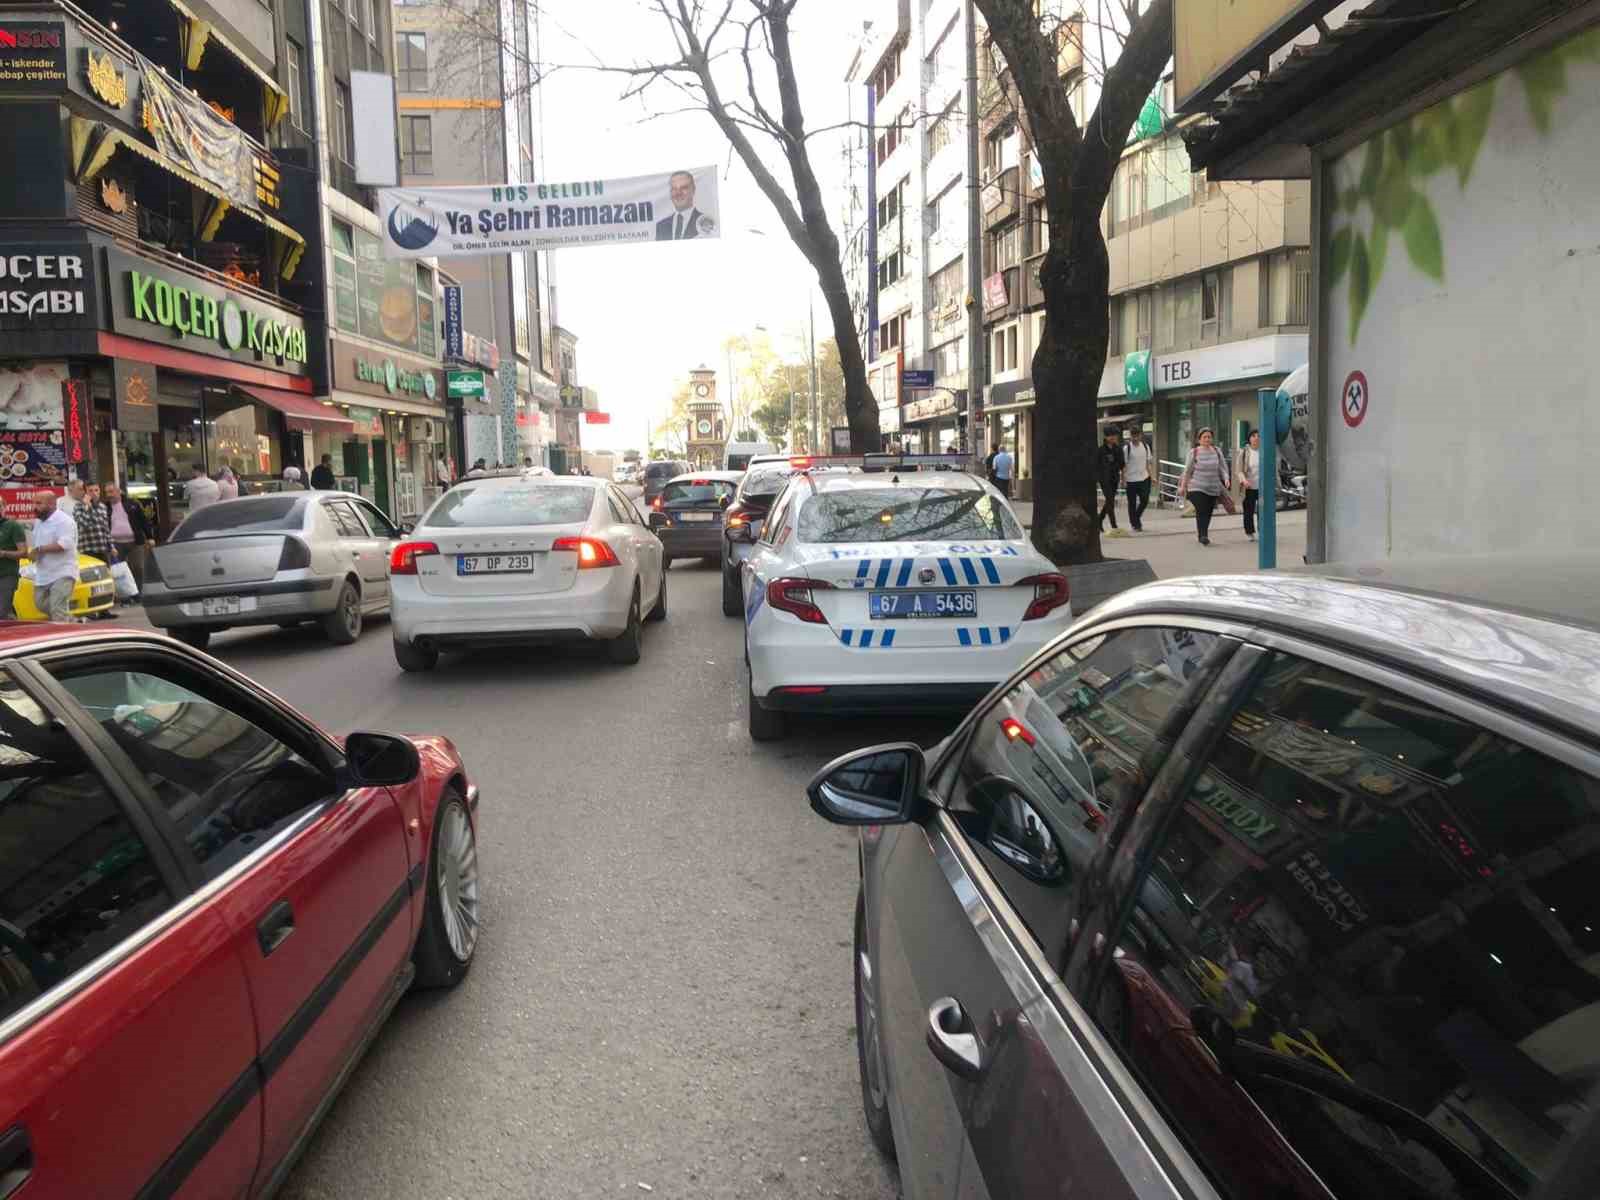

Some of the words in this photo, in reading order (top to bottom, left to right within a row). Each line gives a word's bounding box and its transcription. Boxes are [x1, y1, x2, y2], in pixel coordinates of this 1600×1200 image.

[491, 185, 529, 203] HOŞ
[445, 210, 473, 236] Ya
[478, 205, 541, 238] Şehri
[546, 200, 654, 228] Ramazan
[130, 270, 219, 339] KOÇER
[246, 310, 307, 364] KASABI
[1161, 361, 1191, 383] TEB
[465, 558, 479, 570] 67
[508, 556, 529, 569] 239
[880, 595, 899, 612] 67
[914, 595, 922, 612] A
[936, 594, 973, 612] 5436
